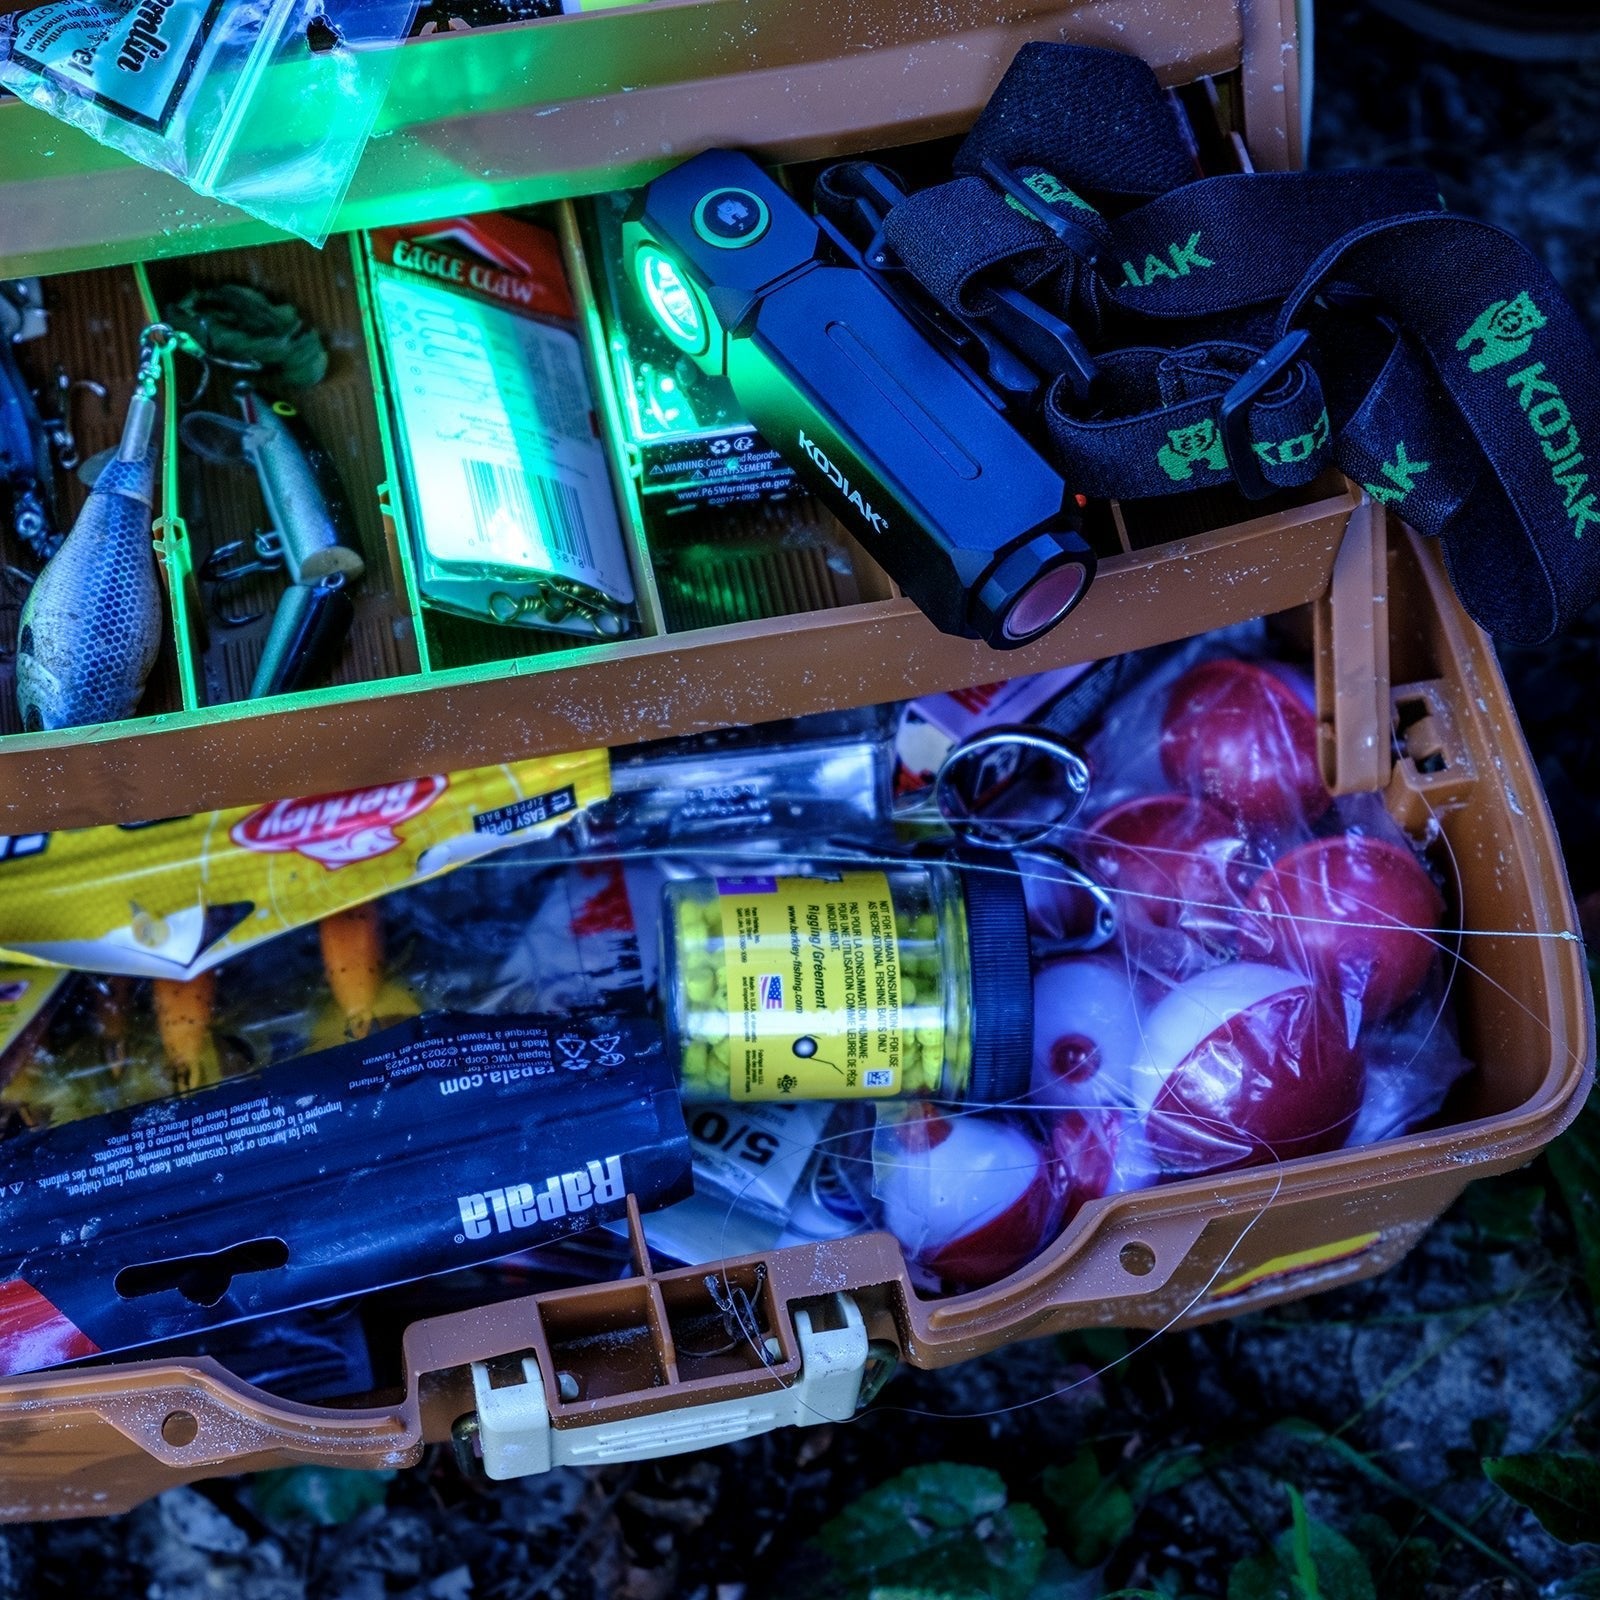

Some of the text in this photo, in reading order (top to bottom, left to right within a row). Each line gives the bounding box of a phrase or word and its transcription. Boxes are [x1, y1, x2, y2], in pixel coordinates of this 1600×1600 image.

[392, 240, 464, 279] EAGLE
[1120, 230, 1216, 288] IAK
[1506, 361, 1600, 540] KODIAK
[663, 460, 707, 473] WARNING:
[678, 478, 791, 501] www.P65Warnings.ca.gov
[799, 430, 883, 535] KODIAK
[258, 779, 417, 840] Berkley
[478, 796, 545, 824] ZIPPER BAG
[480, 807, 547, 837] EASY OPEN
[837, 903, 848, 920] POUR
[849, 902, 860, 914] PAS
[868, 901, 877, 910] AS
[826, 904, 840, 952] UNIQUEMENT.
[839, 923, 850, 937] UNE
[851, 916, 861, 936] POUR
[853, 938, 862, 949] LA
[869, 911, 883, 969] RECREATIONAL
[787, 905, 804, 1014] www.berkley-fishing.com
[842, 940, 854, 990] UTILISATION
[855, 950, 868, 1022] CONSUMMATION
[875, 971, 886, 1005] FISHING
[879, 900, 899, 1067] NOT FOR HUMAN CONSUMPTION FOR USE
[844, 993, 856, 1026] COMME
[362, 1027, 547, 1066] Fabriqué à Taiwan Hecho en Taiwan
[470, 1043, 506, 1054] Taiwan
[509, 1042, 519, 1050] in
[521, 1039, 549, 1049] Made
[846, 1028, 857, 1057] LEURRE
[878, 1034, 887, 1053] ONLY
[385, 1056, 410, 1070] 0423
[426, 1057, 458, 1070] 17200
[491, 1054, 515, 1062] VMC
[517, 1050, 551, 1061] Rapala
[847, 1059, 856, 1068] DE
[348, 1074, 385, 1090] Finland
[440, 1065, 556, 1096] rapala.com
[304, 1100, 343, 1120] Impropre
[105, 1097, 269, 1147] Mantener fuera del alcance de los niños.
[224, 1118, 286, 1142] consommation
[287, 1115, 296, 1127] la
[301, 1122, 317, 1136] Not
[91, 1105, 285, 1163] No apto para consumo humano o de mascotas.
[186, 1134, 223, 1152] humaine
[257, 1131, 287, 1149] human
[288, 1128, 301, 1141] for
[691, 1112, 780, 1167] 5/0
[173, 1144, 185, 1155] ou
[229, 1140, 245, 1155] pet
[245, 1139, 256, 1150] or
[106, 1157, 134, 1175] Garder
[172, 1145, 228, 1171] consumption.
[72, 1169, 87, 1183] des
[89, 1165, 105, 1179] loin
[124, 1166, 148, 1180] away
[148, 1159, 171, 1176] Keep
[36, 1172, 70, 1192] enfants.
[103, 1174, 123, 1190] from
